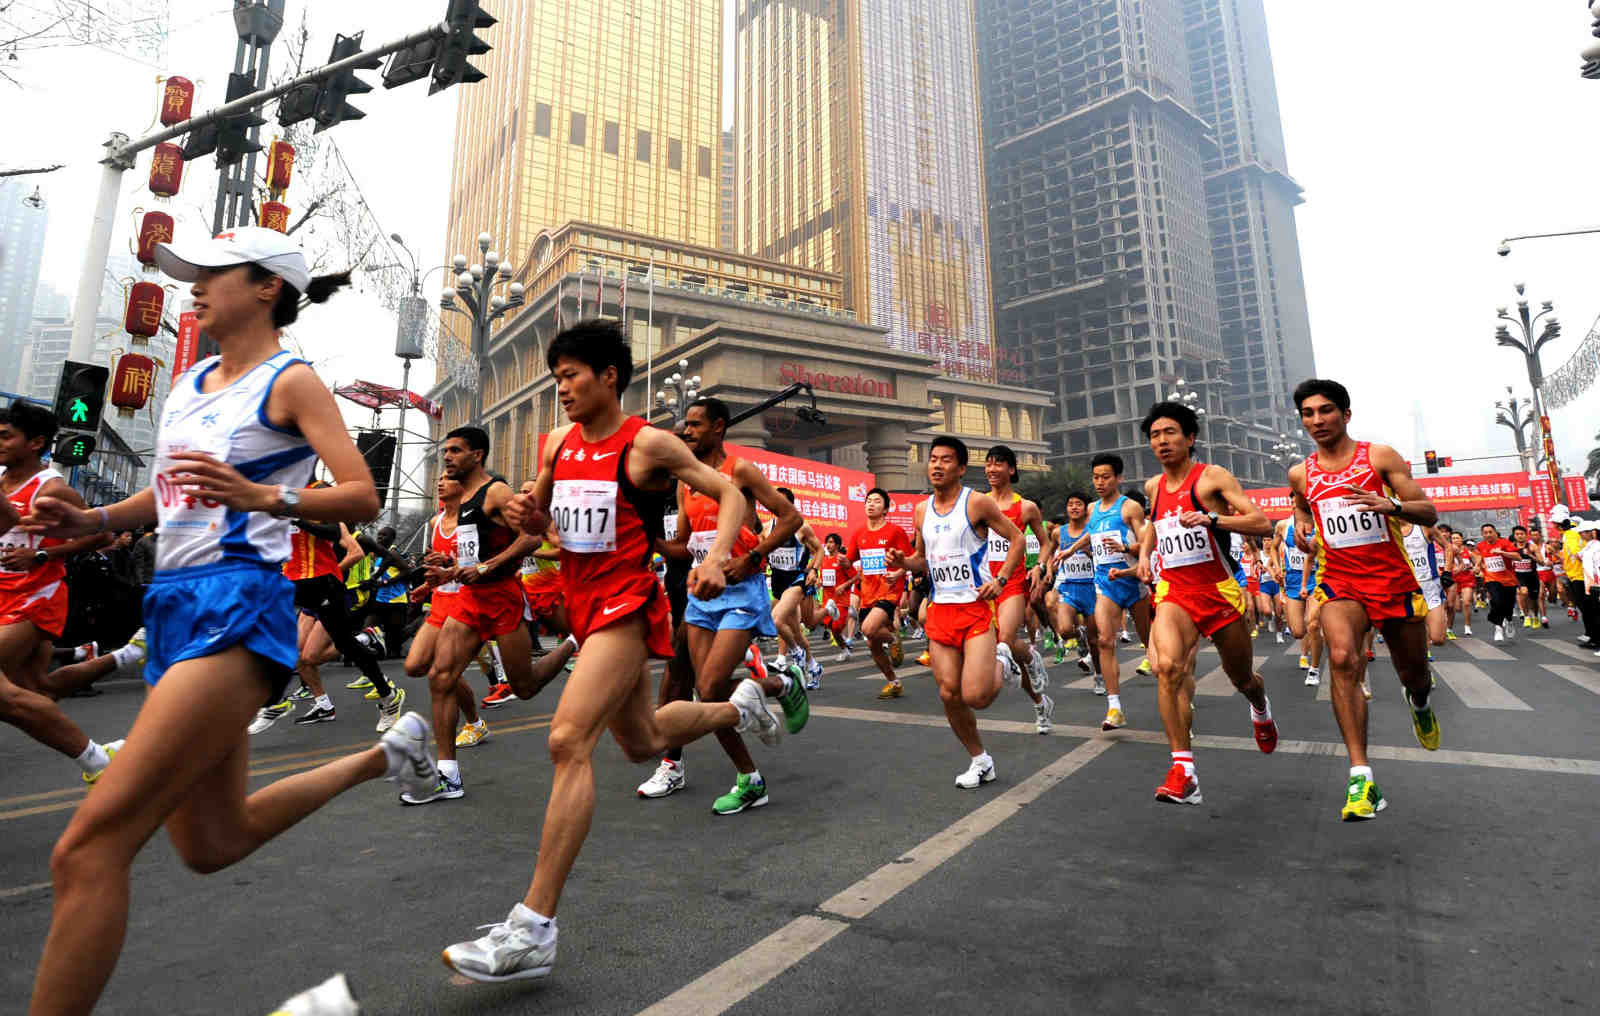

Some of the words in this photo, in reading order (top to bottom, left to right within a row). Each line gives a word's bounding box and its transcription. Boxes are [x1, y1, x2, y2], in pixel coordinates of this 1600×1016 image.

[136, 295, 161, 326] 吉
[123, 367, 151, 400] 祥
[779, 361, 894, 398] Sheraton
[553, 507, 609, 534] 00117
[1326, 512, 1383, 536] 00161
[1160, 531, 1206, 556] 00105
[932, 564, 970, 582] 00126
